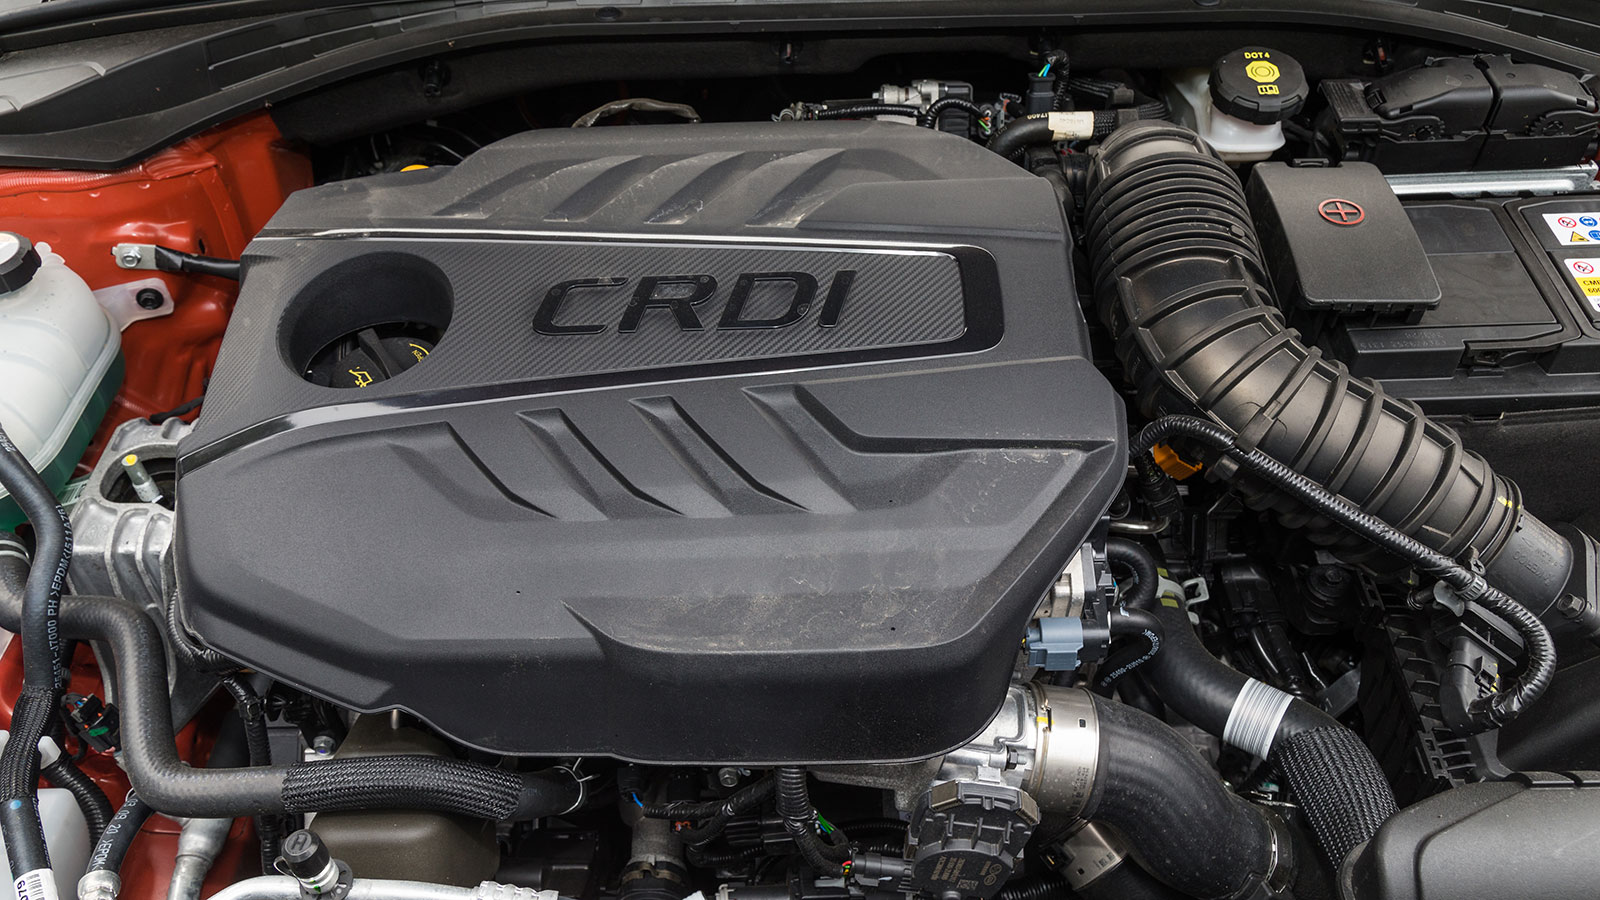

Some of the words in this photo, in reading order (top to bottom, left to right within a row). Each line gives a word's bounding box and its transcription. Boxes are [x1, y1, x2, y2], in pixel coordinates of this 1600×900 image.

[533, 269, 857, 335] CRDI
[47, 599, 58, 616] PH
[47, 620, 61, 689] 25451-J7000
[106, 824, 121, 834] 20
